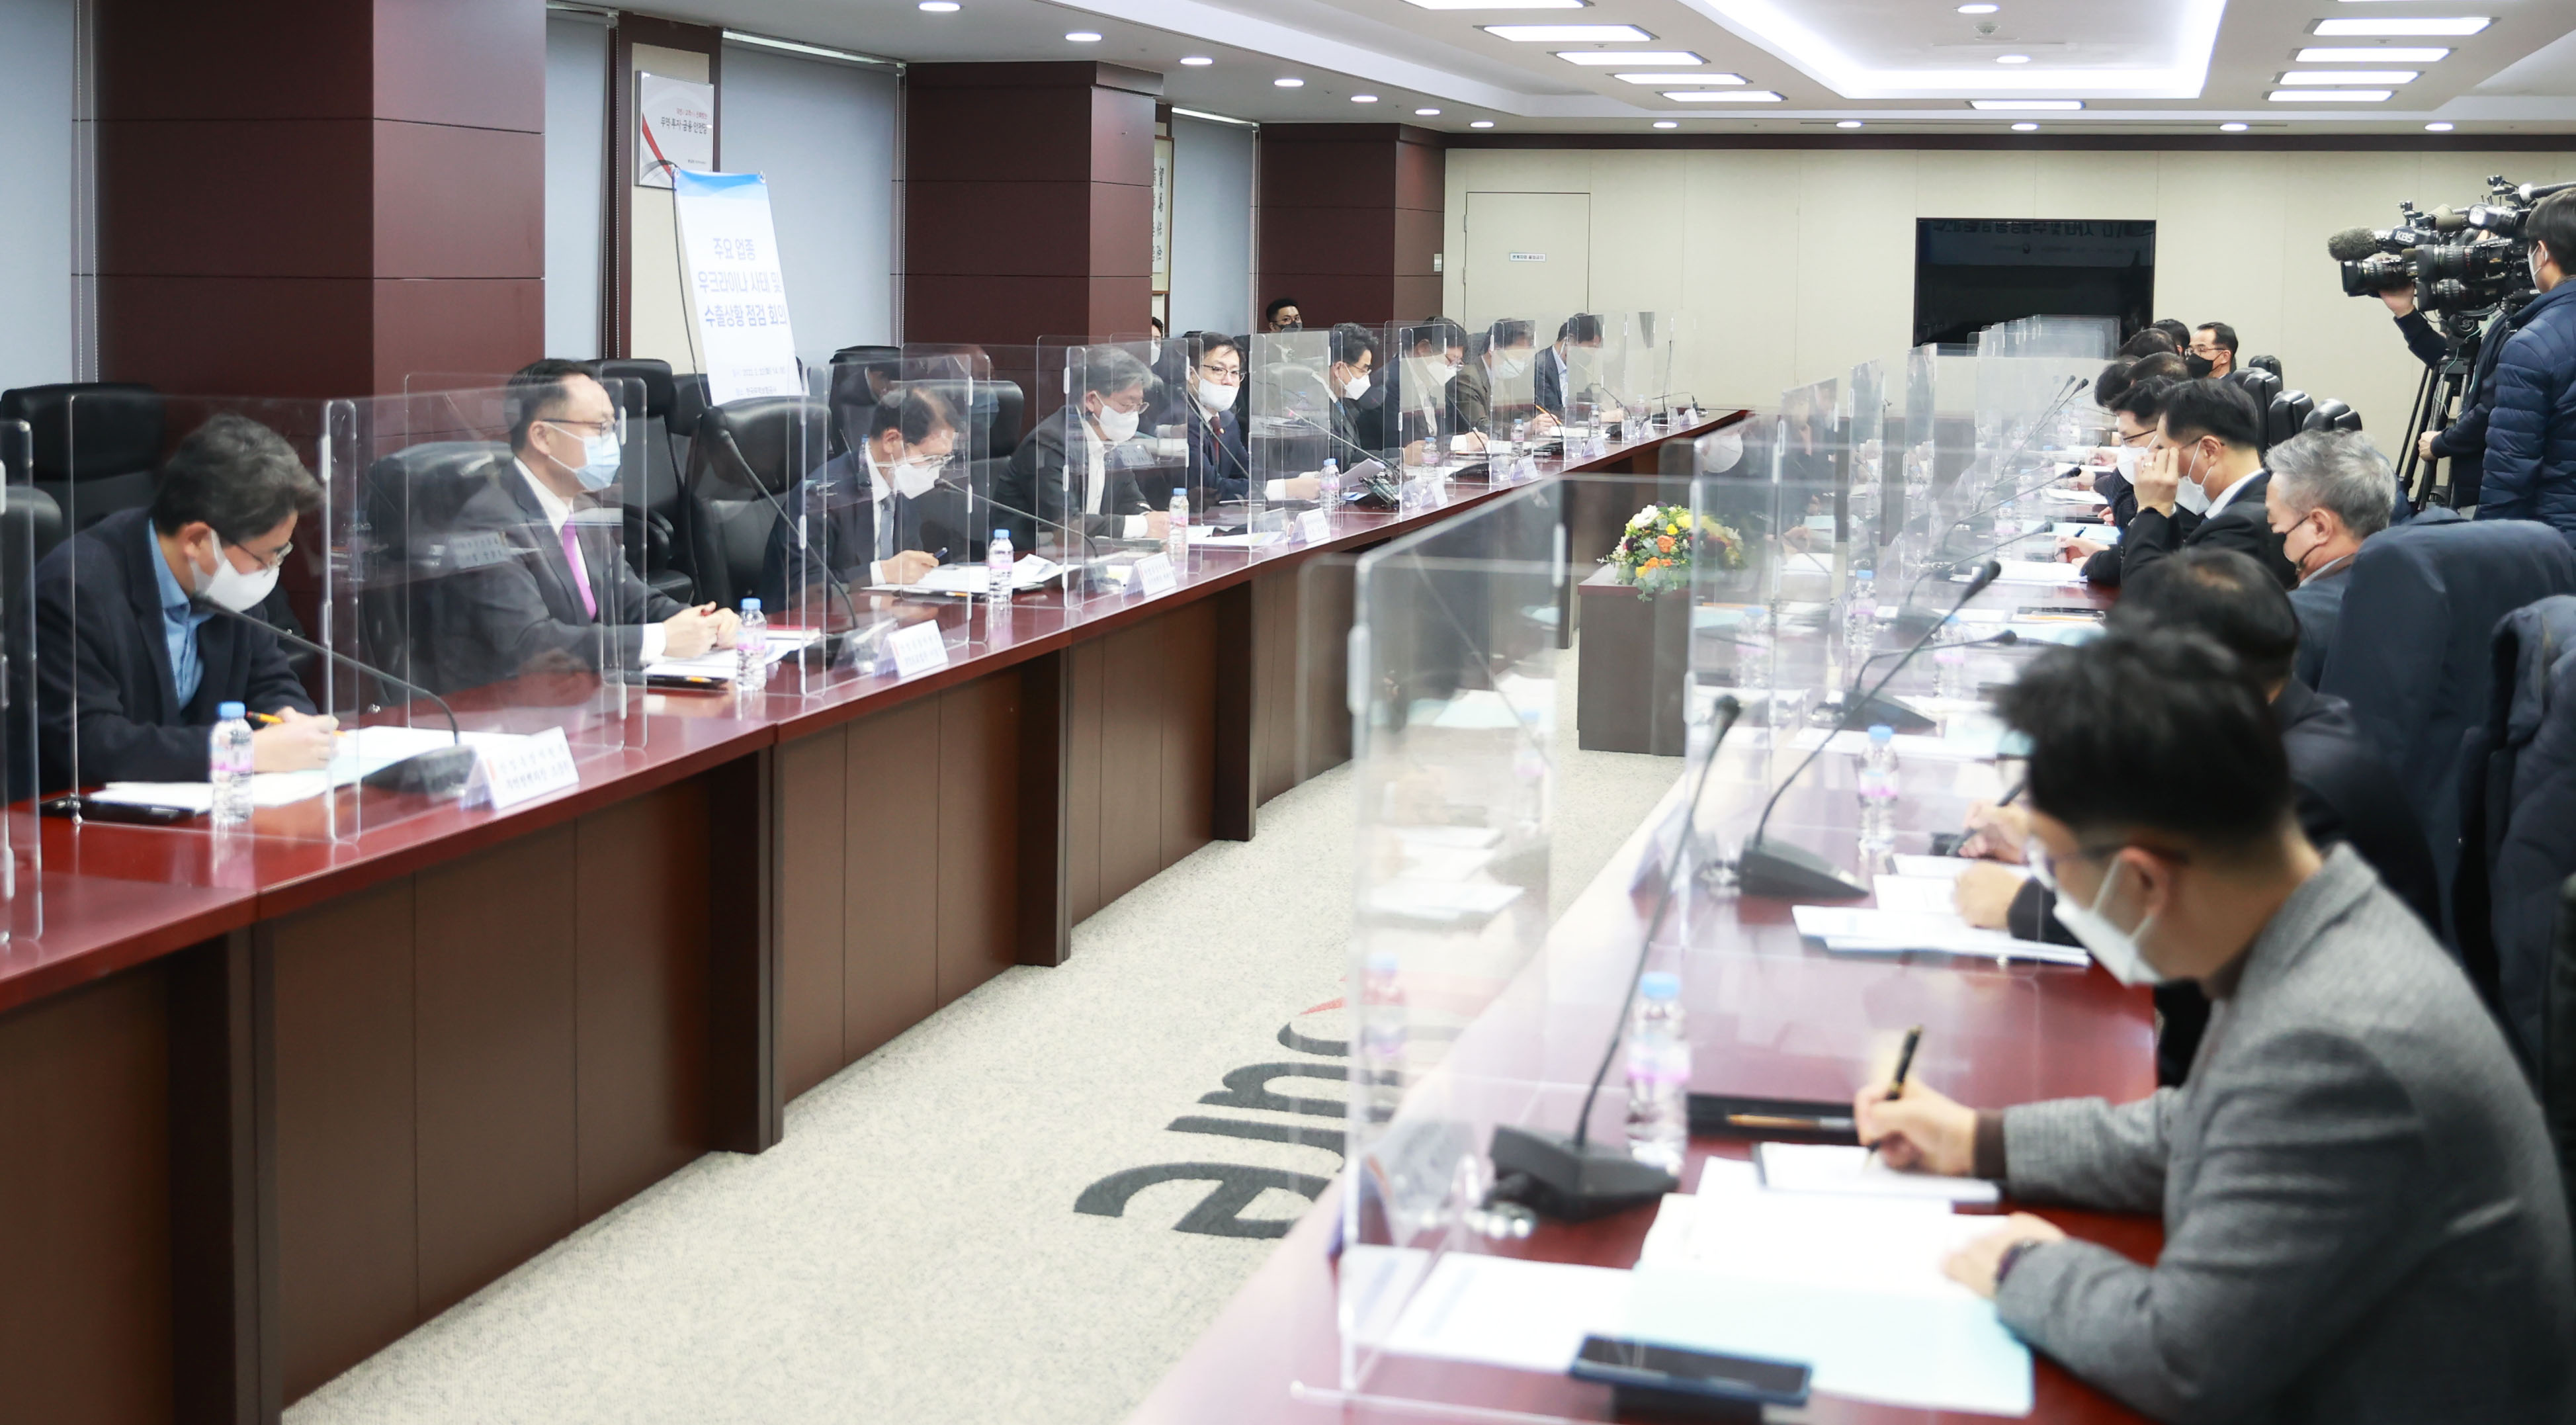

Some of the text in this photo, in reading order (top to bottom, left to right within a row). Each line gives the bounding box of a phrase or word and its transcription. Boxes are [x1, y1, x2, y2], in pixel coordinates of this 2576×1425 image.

[2395, 230, 2415, 243] KBS
[713, 238, 755, 261] 주요 업종
[698, 271, 783, 293] 우크라이나 사태 및
[705, 304, 787, 327] 수출상황 점검 회의
